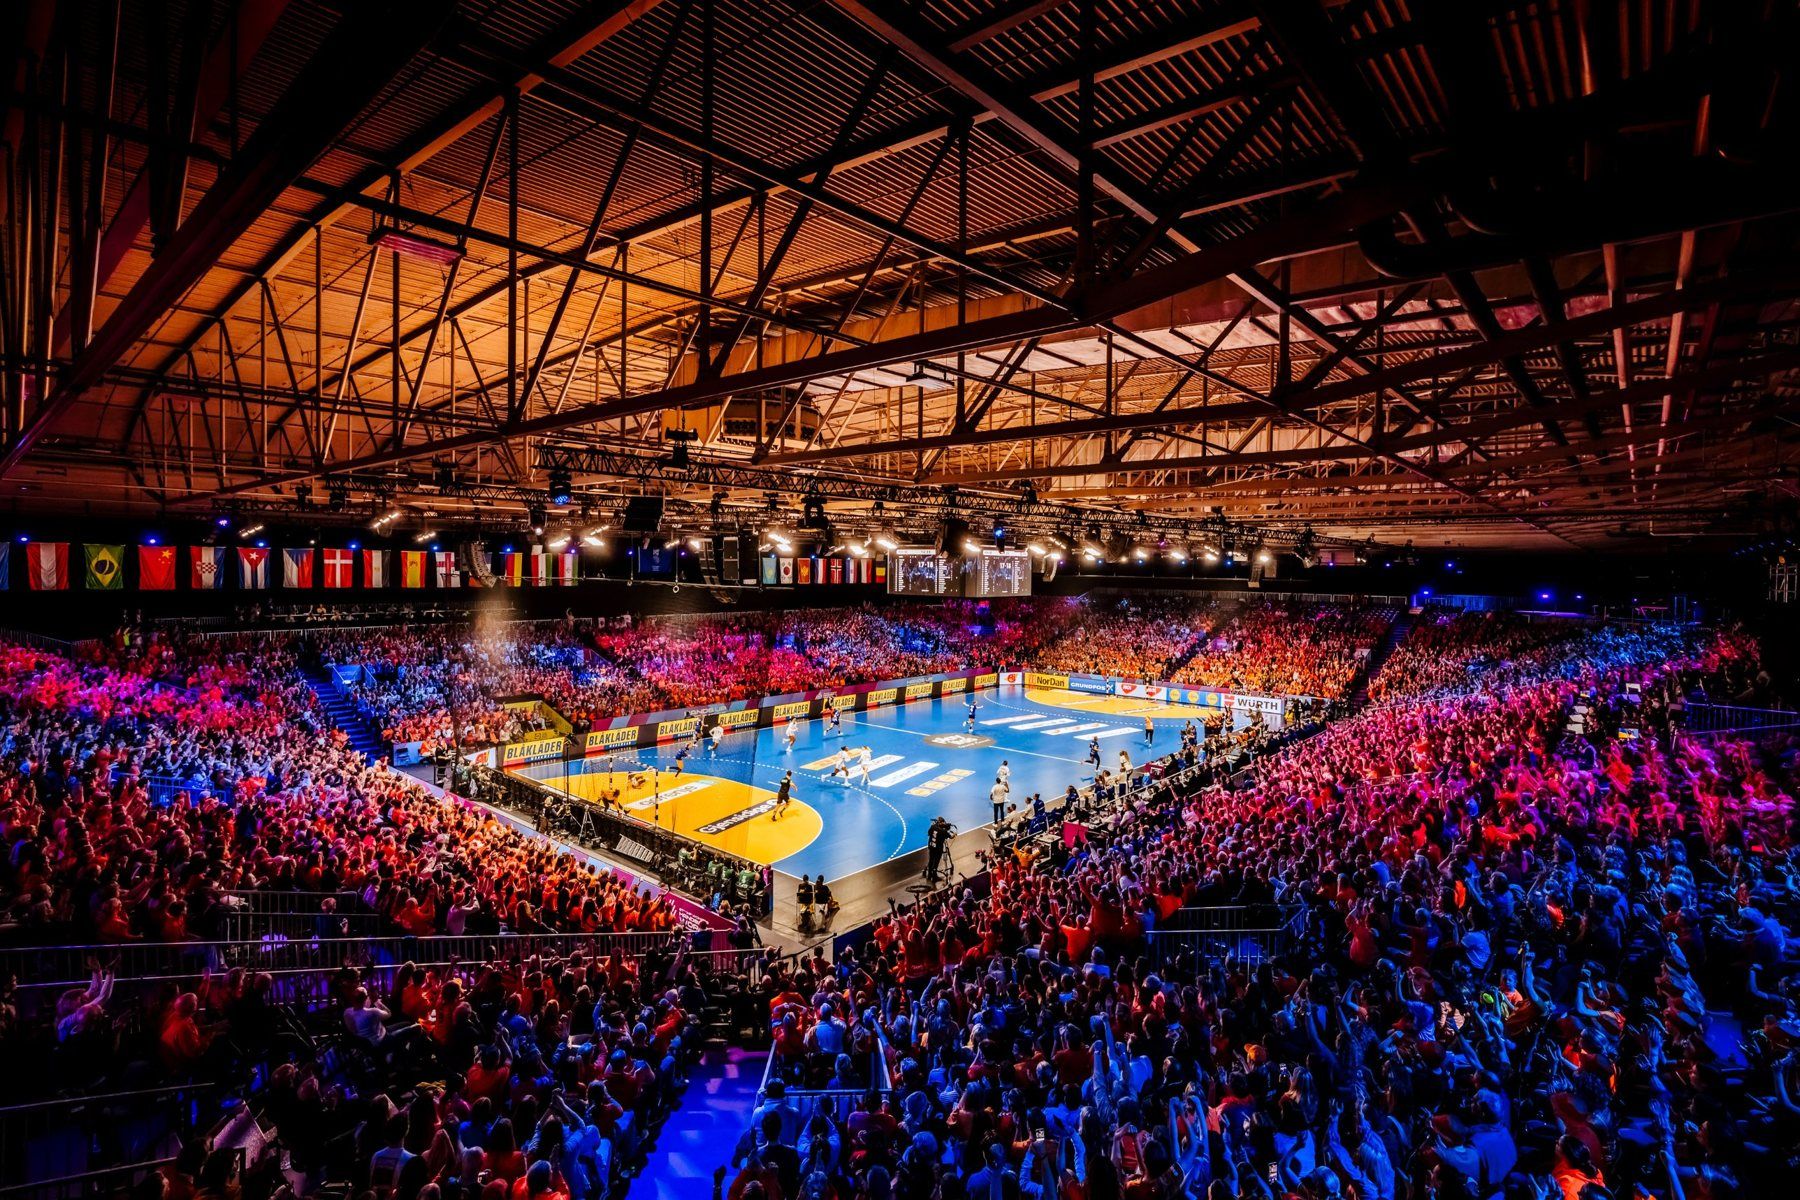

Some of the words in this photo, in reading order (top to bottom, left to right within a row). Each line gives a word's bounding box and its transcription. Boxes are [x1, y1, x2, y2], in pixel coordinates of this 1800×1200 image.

[1036, 675, 1065, 687] NorDan
[1070, 682, 1106, 691] GRUNDFOS
[774, 703, 809, 716] BLÅKLÄDER
[1237, 698, 1279, 711] WÜRTH
[720, 712, 758, 725] BLÅKLÄDER
[588, 729, 637, 746] BLÅKLÄDER
[506, 740, 562, 759] BLÅKLÄDER
[699, 802, 773, 834] Gjensidige
